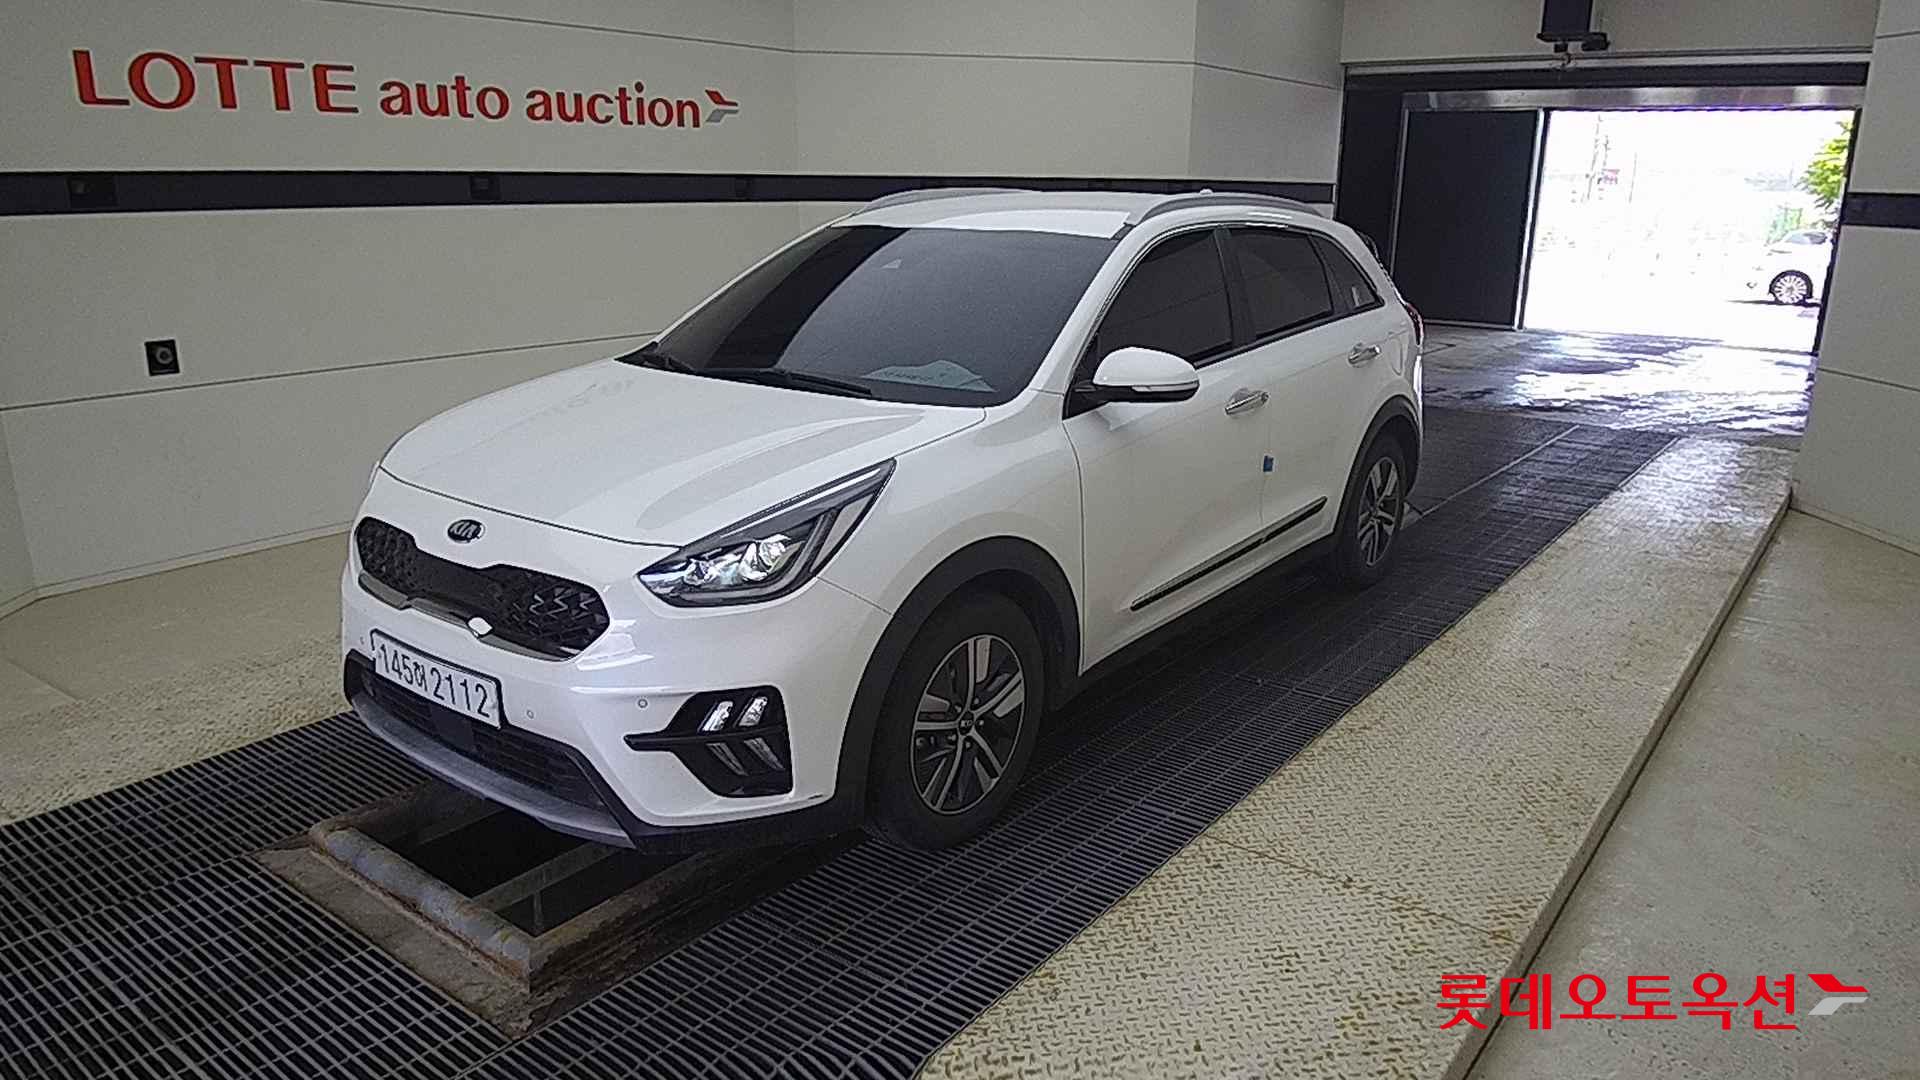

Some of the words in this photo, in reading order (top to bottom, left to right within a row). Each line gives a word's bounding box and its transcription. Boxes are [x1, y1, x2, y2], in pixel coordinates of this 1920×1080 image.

[73, 49, 359, 113] LOTTE
[379, 75, 509, 120] auto
[526, 81, 700, 128] auction
